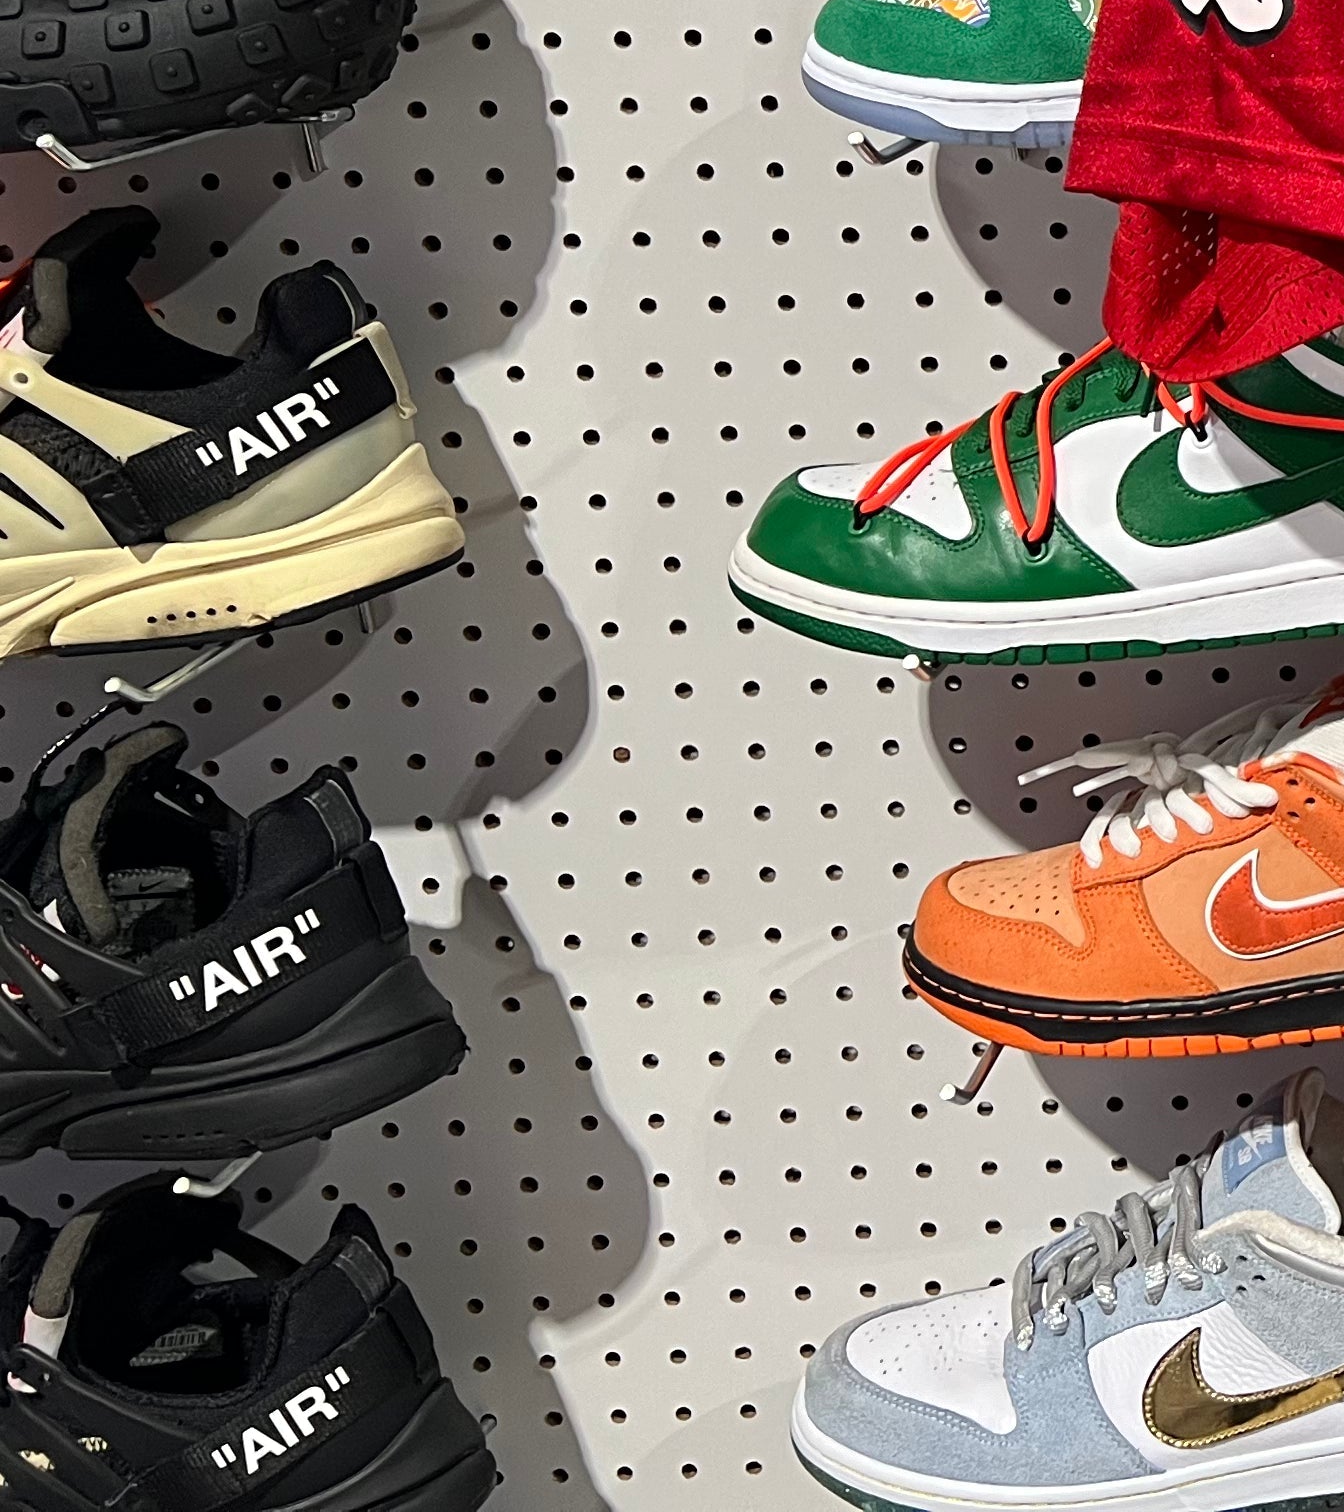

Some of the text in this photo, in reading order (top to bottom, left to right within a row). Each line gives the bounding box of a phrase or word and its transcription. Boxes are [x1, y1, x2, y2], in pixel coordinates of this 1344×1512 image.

[195, 377, 340, 476] "AIR"
[168, 908, 321, 1012] "AIR"
[211, 1366, 351, 1475] "AIR"
